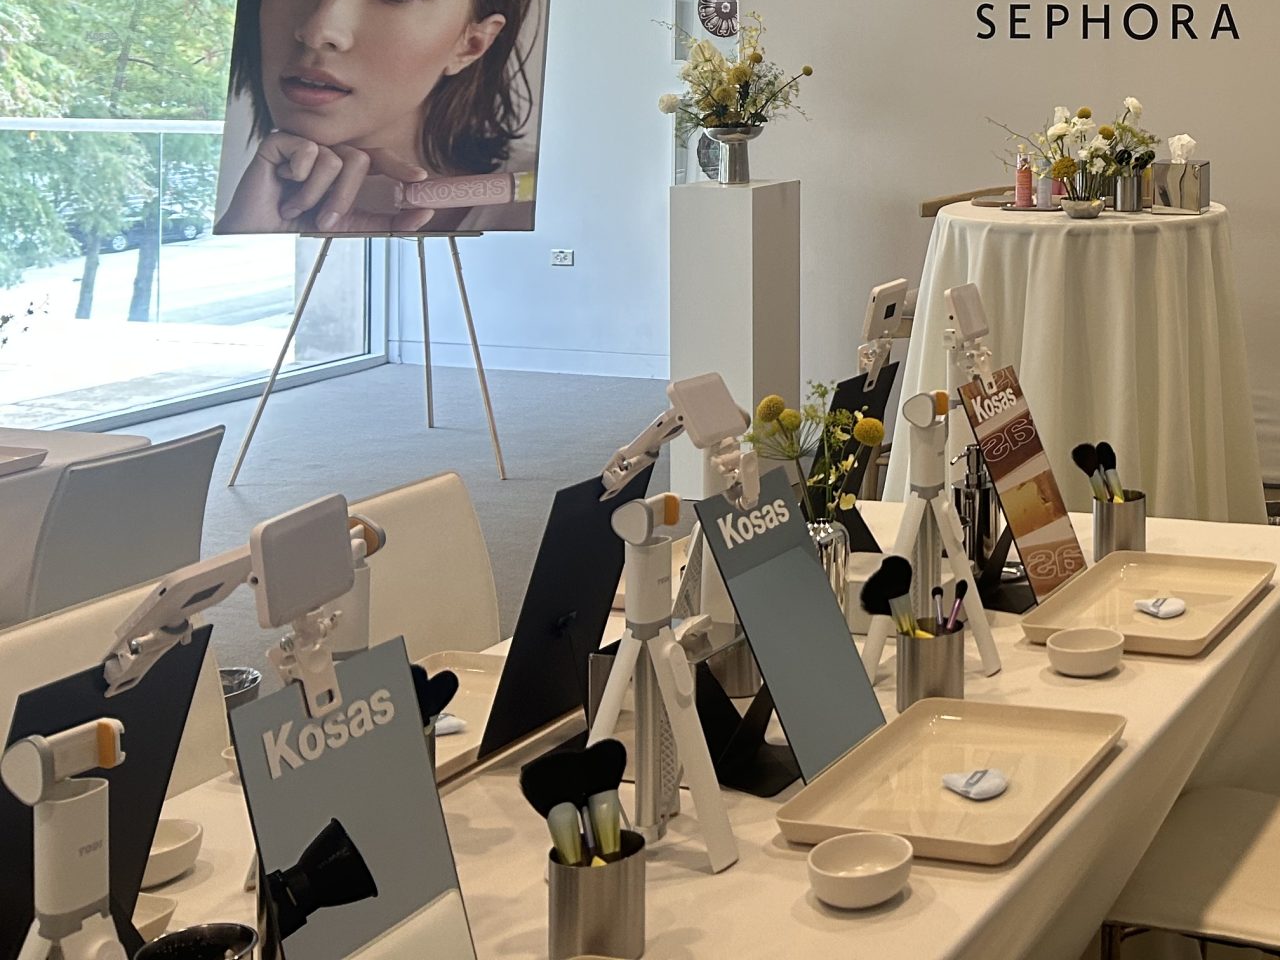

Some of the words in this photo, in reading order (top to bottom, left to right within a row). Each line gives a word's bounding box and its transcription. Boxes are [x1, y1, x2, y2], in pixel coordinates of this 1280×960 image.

[976, 3, 1240, 41] SEPHORA
[411, 177, 507, 205] Kosas
[971, 388, 1017, 423] Kosas
[717, 498, 790, 550] Kosas
[263, 688, 395, 780] Kosas
